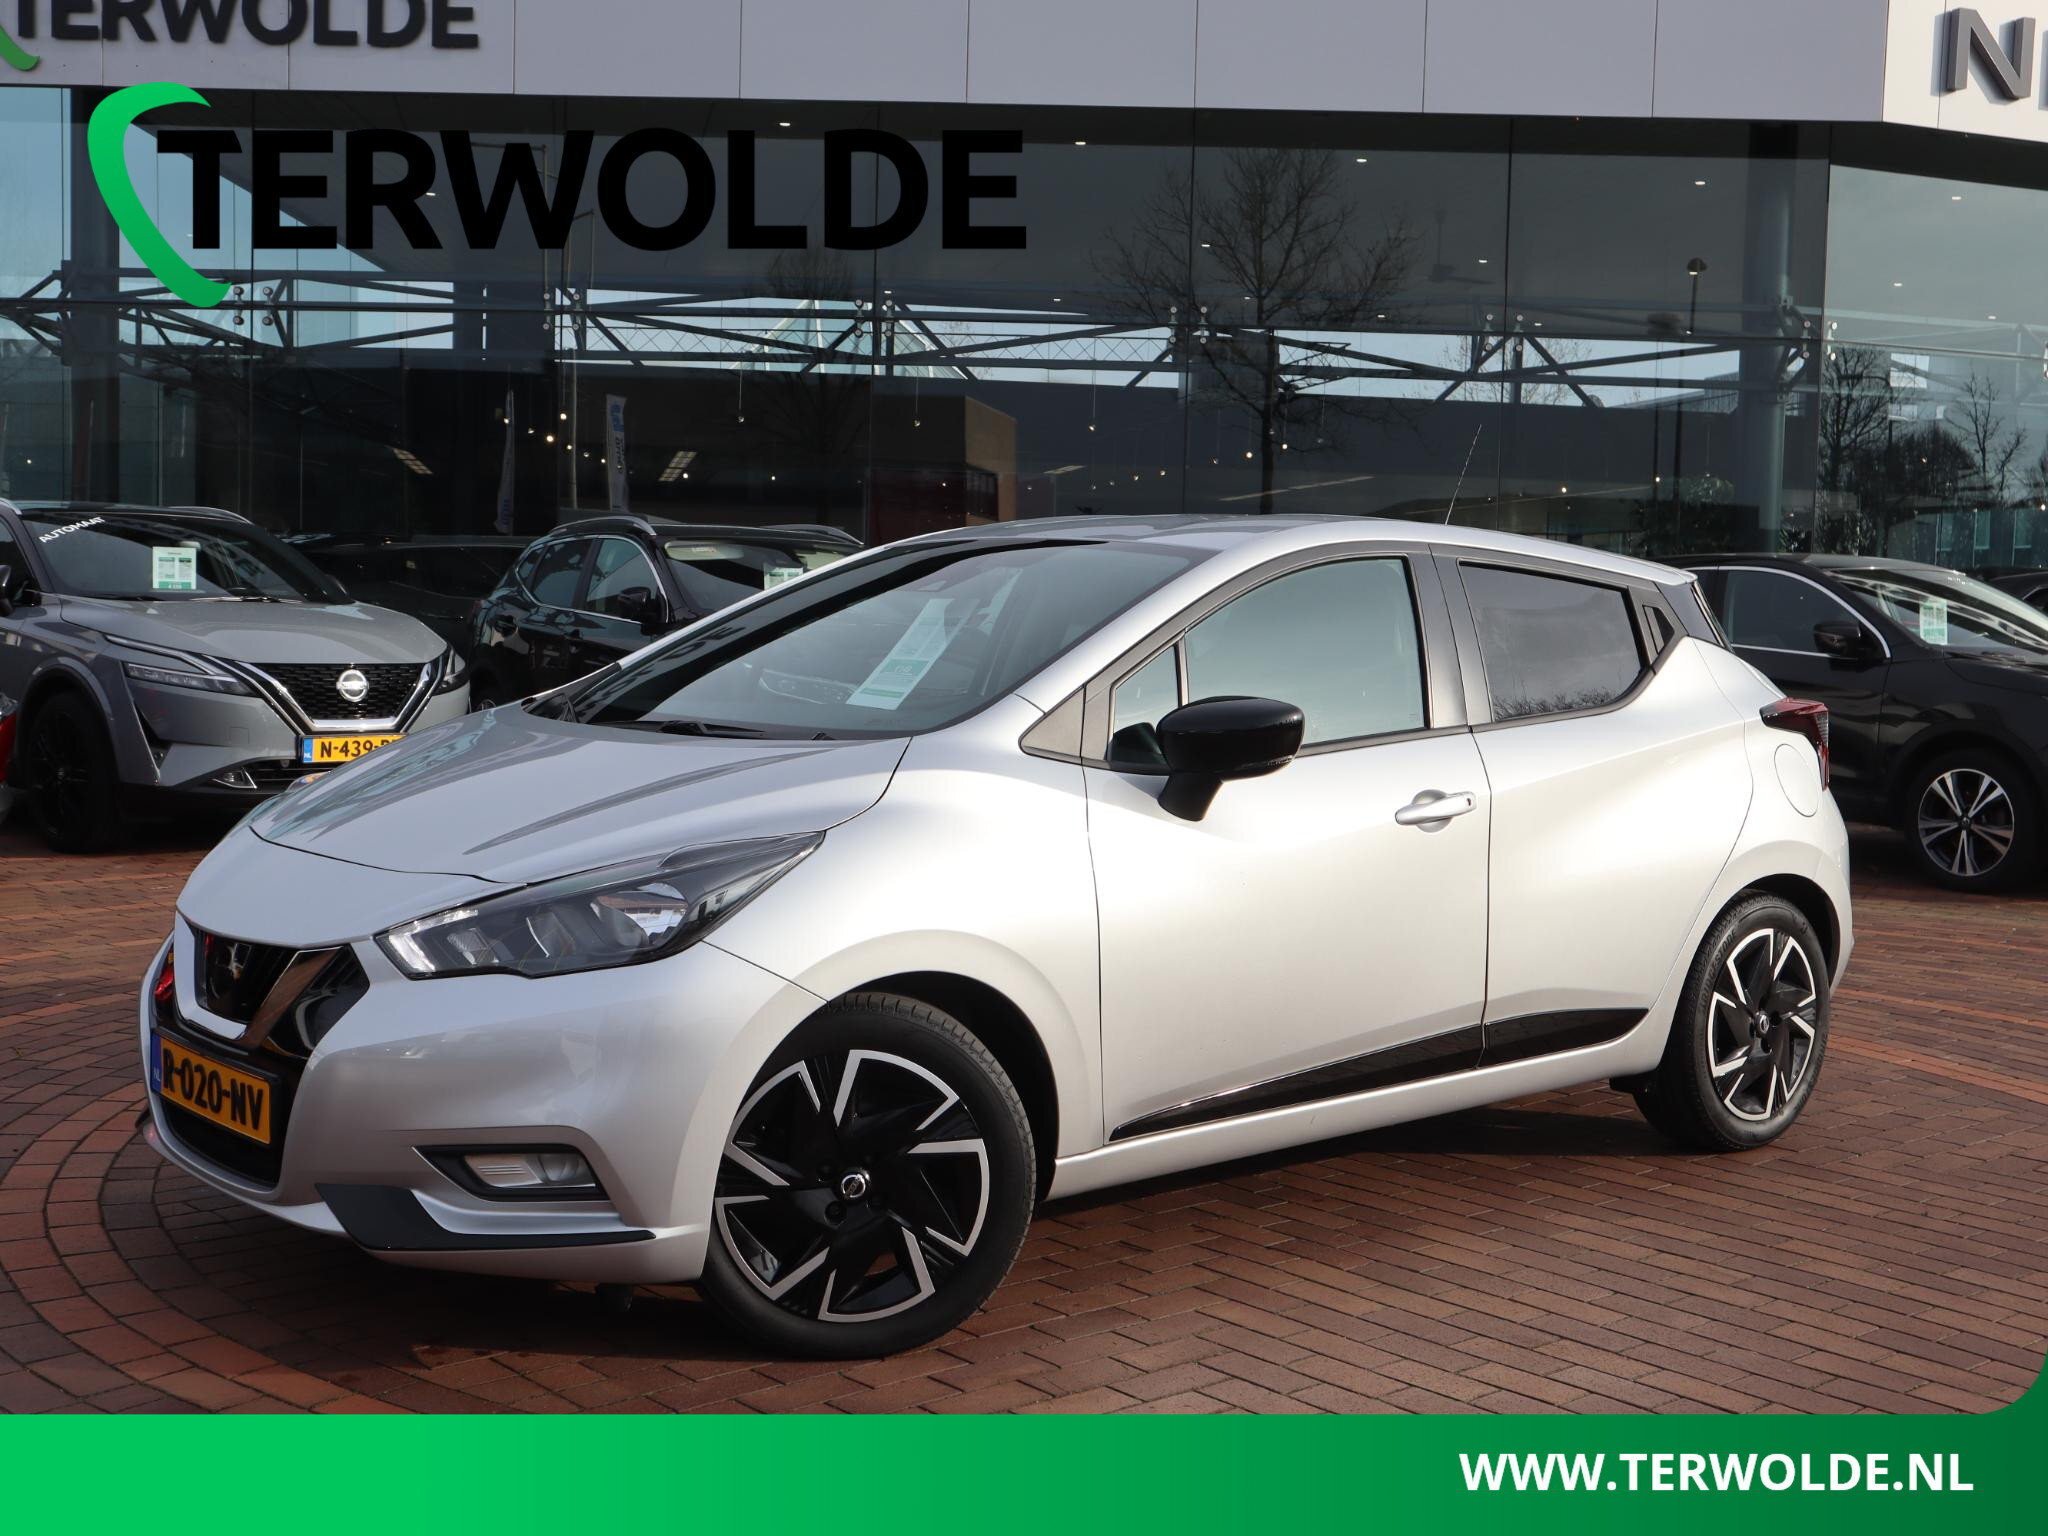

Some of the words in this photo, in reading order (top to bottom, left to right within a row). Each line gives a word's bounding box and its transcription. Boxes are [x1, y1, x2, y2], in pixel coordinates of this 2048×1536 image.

[1943, 7, 2048, 107] N
[38, 516, 107, 543] AUTOMAAT
[163, 1048, 264, 1131] R-020-NV
